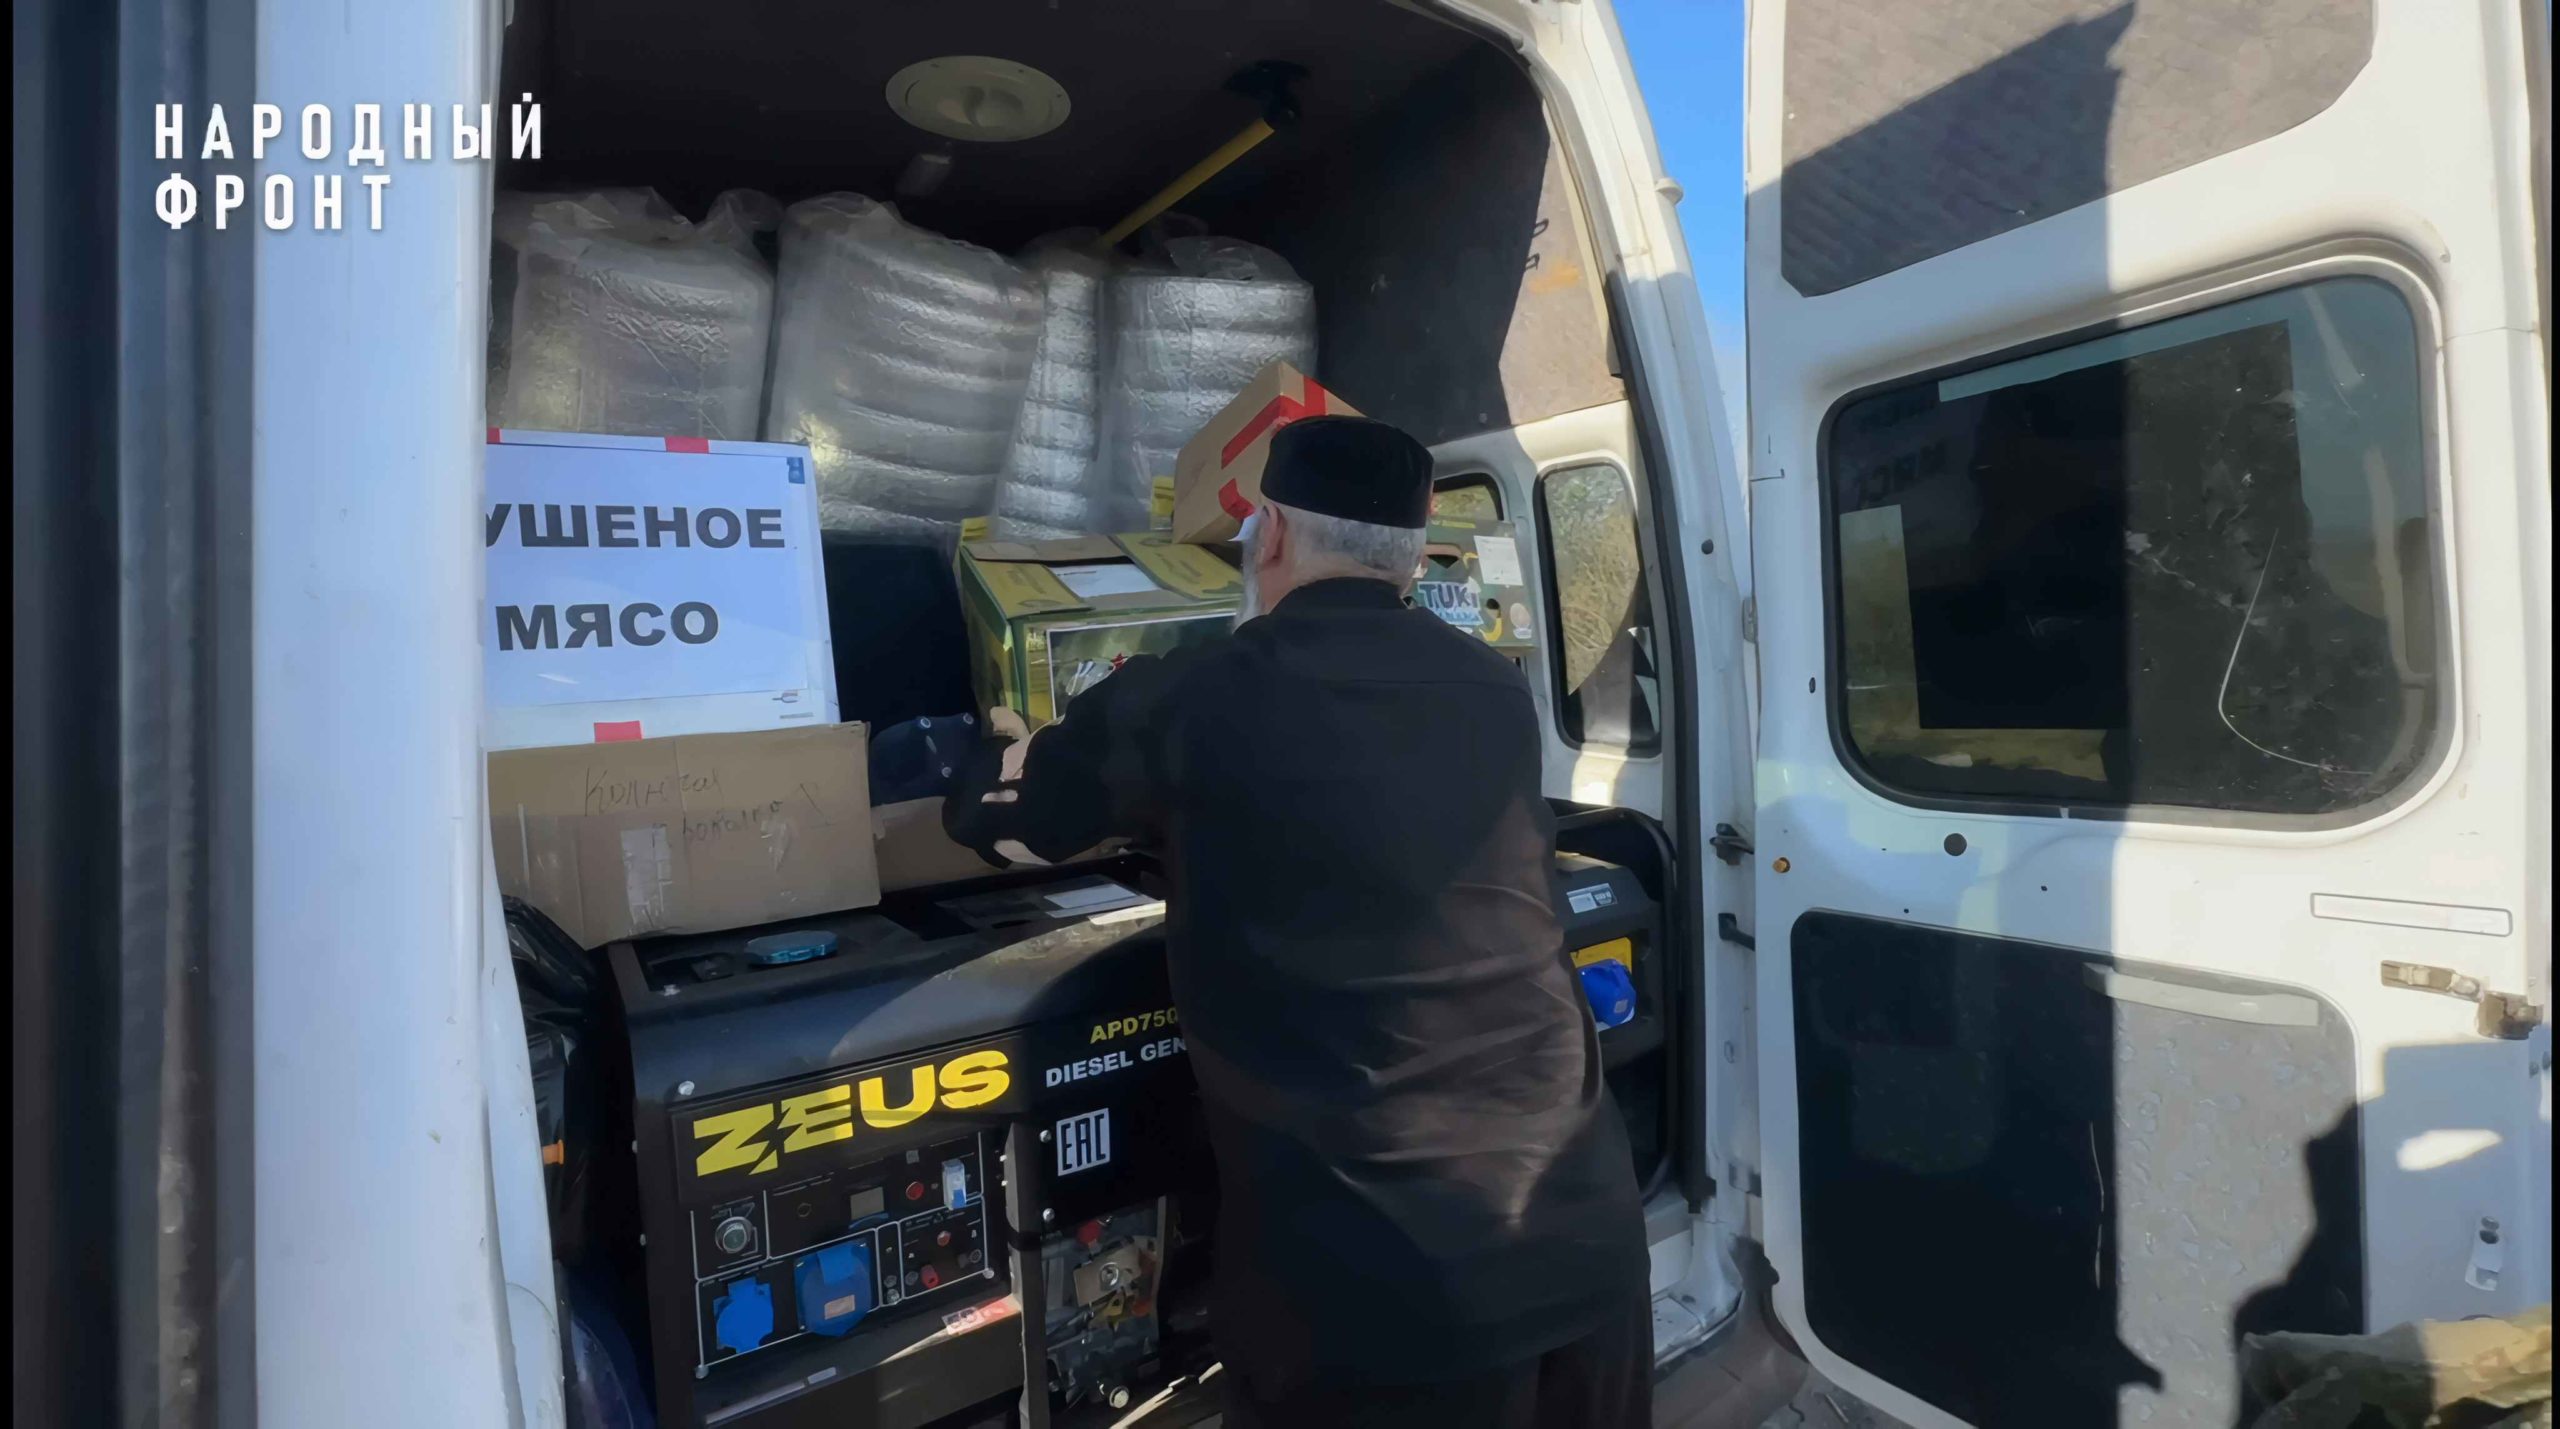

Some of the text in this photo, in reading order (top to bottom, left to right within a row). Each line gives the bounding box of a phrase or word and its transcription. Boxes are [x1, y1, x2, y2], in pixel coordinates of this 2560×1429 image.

[495, 601, 720, 651] МЯСО
[1045, 1050, 1134, 1089] DIESEL
[692, 1050, 1011, 1178] ZEUS
[1058, 1110, 1109, 1173] EAC
